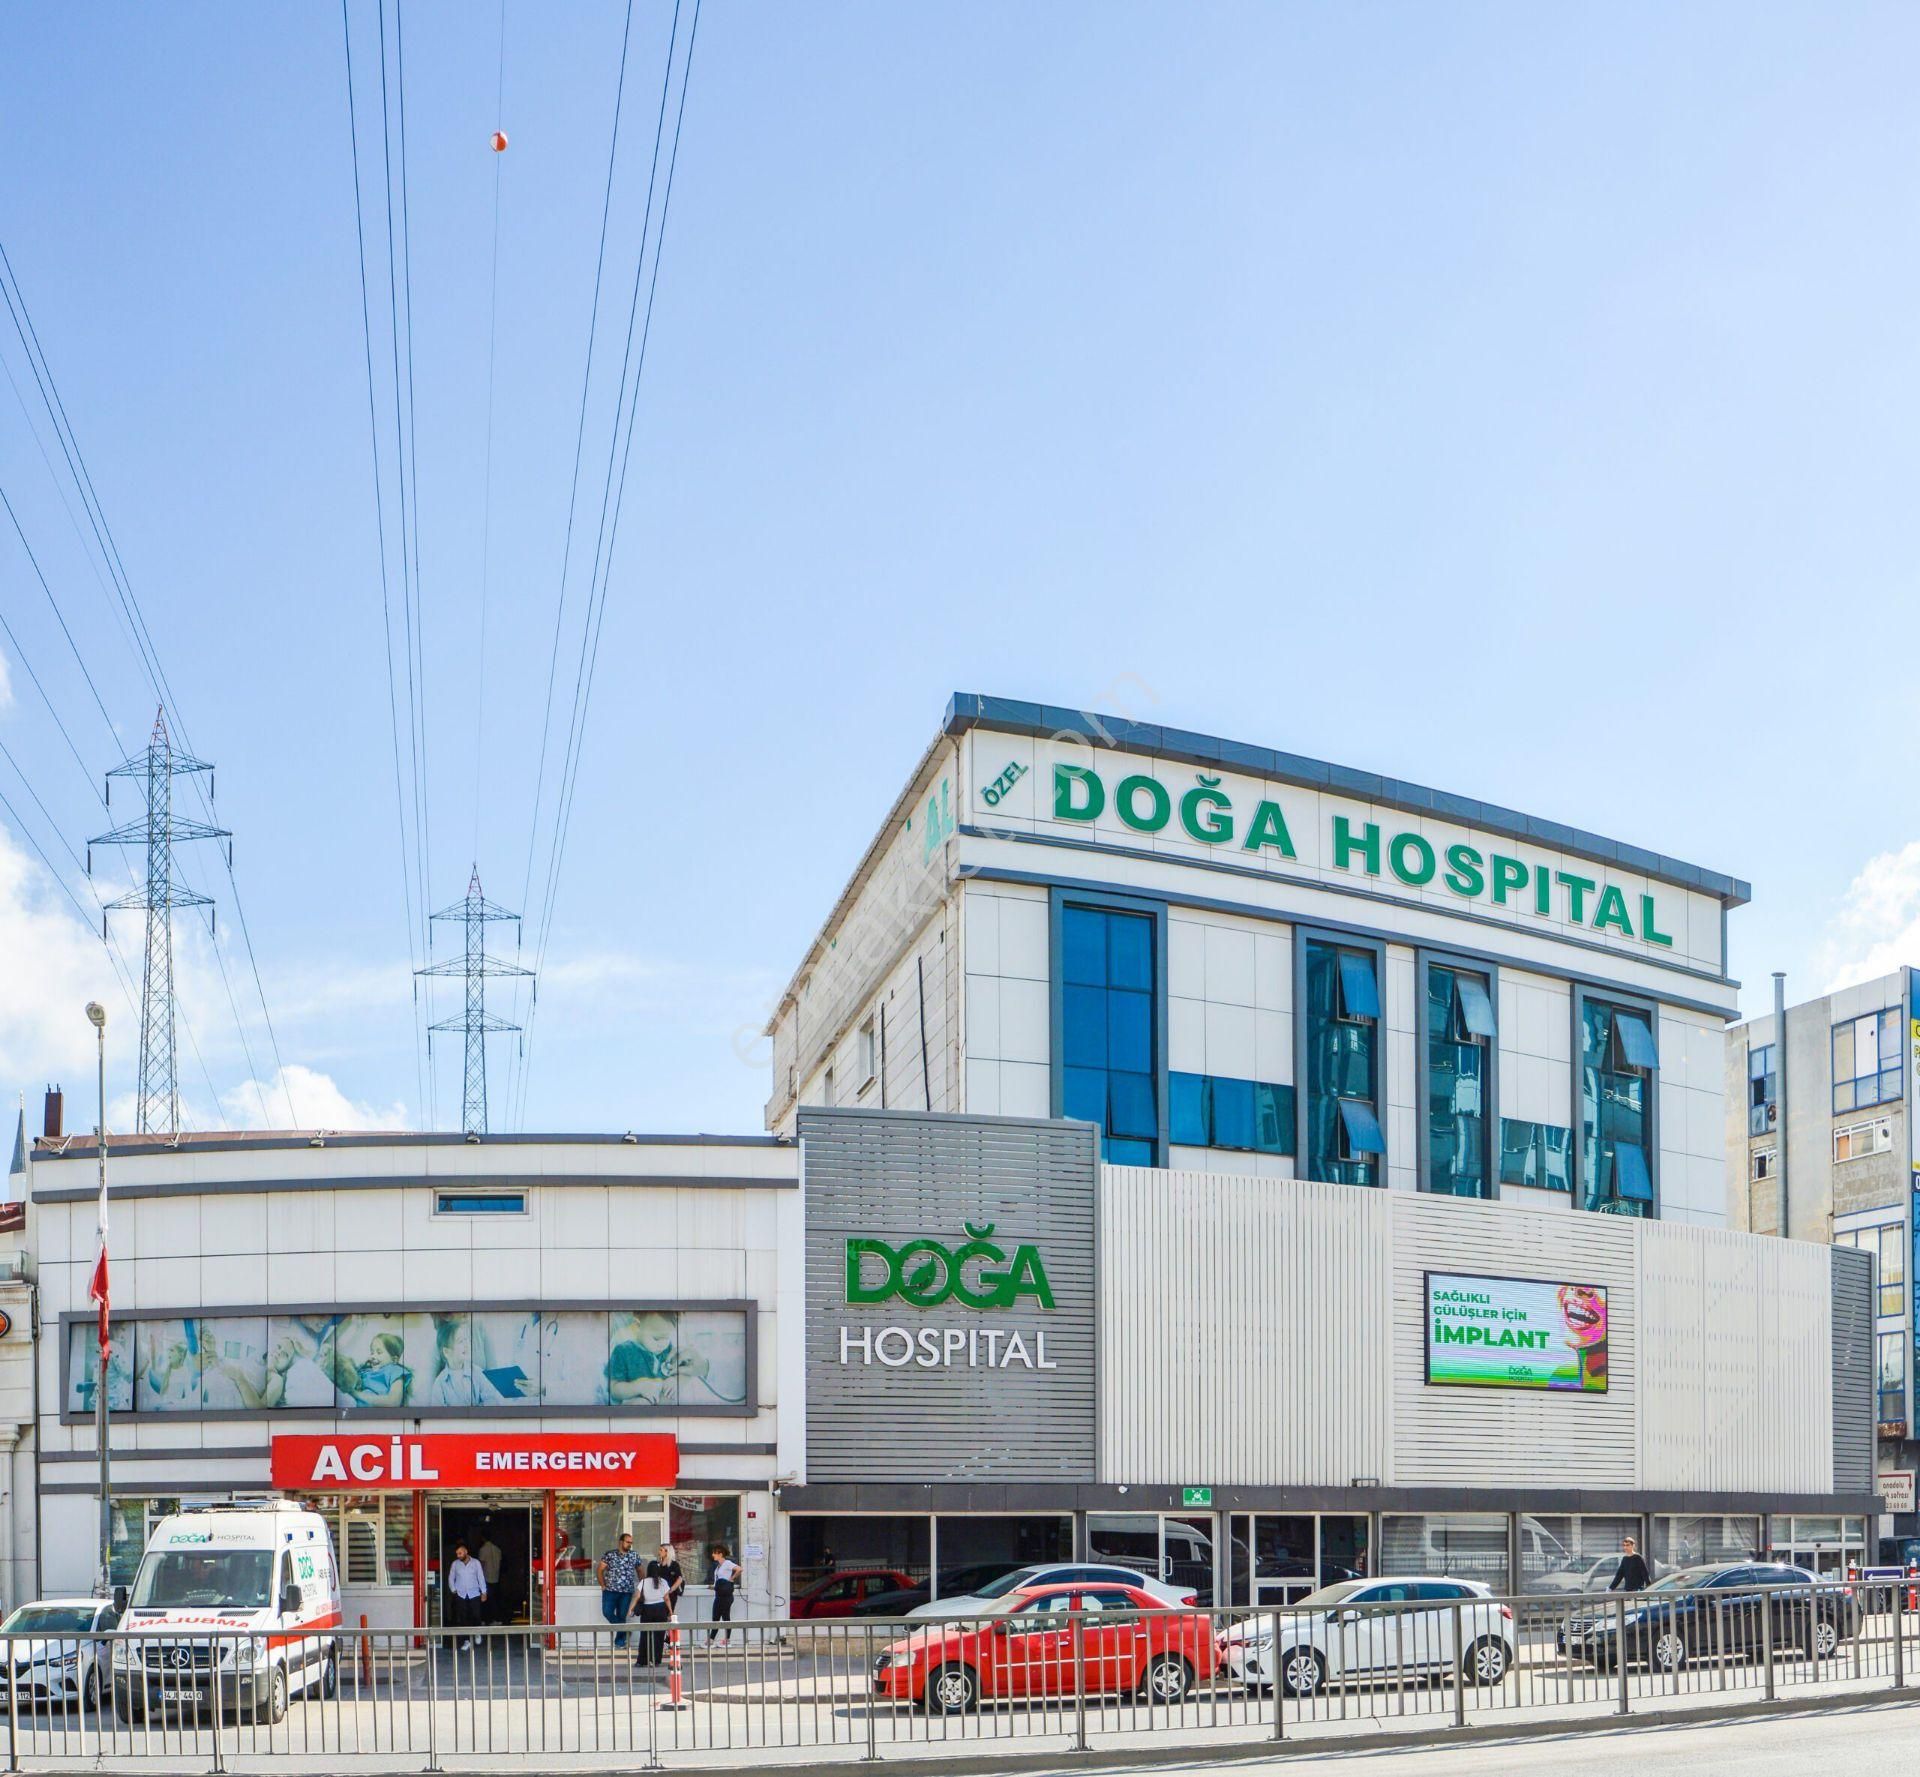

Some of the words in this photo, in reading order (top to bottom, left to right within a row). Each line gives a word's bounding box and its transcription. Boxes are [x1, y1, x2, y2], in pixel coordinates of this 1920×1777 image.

[981, 761, 1029, 807] ÖZEL
[1053, 763, 1297, 860] DOĞA
[1332, 815, 1673, 947] HOSPITAL
[845, 1222, 1056, 1310] DOĞA
[1433, 1289, 1490, 1304] SAĞLIKLI
[1433, 1305, 1499, 1322] GÜLÜŞLER
[1502, 1307, 1527, 1323] İÇİN
[840, 1326, 1057, 1369] HOSPITAL
[1434, 1317, 1550, 1349] İMPLANT
[310, 1436, 439, 1481] ACİL
[475, 1451, 637, 1471] EMERGENCY
